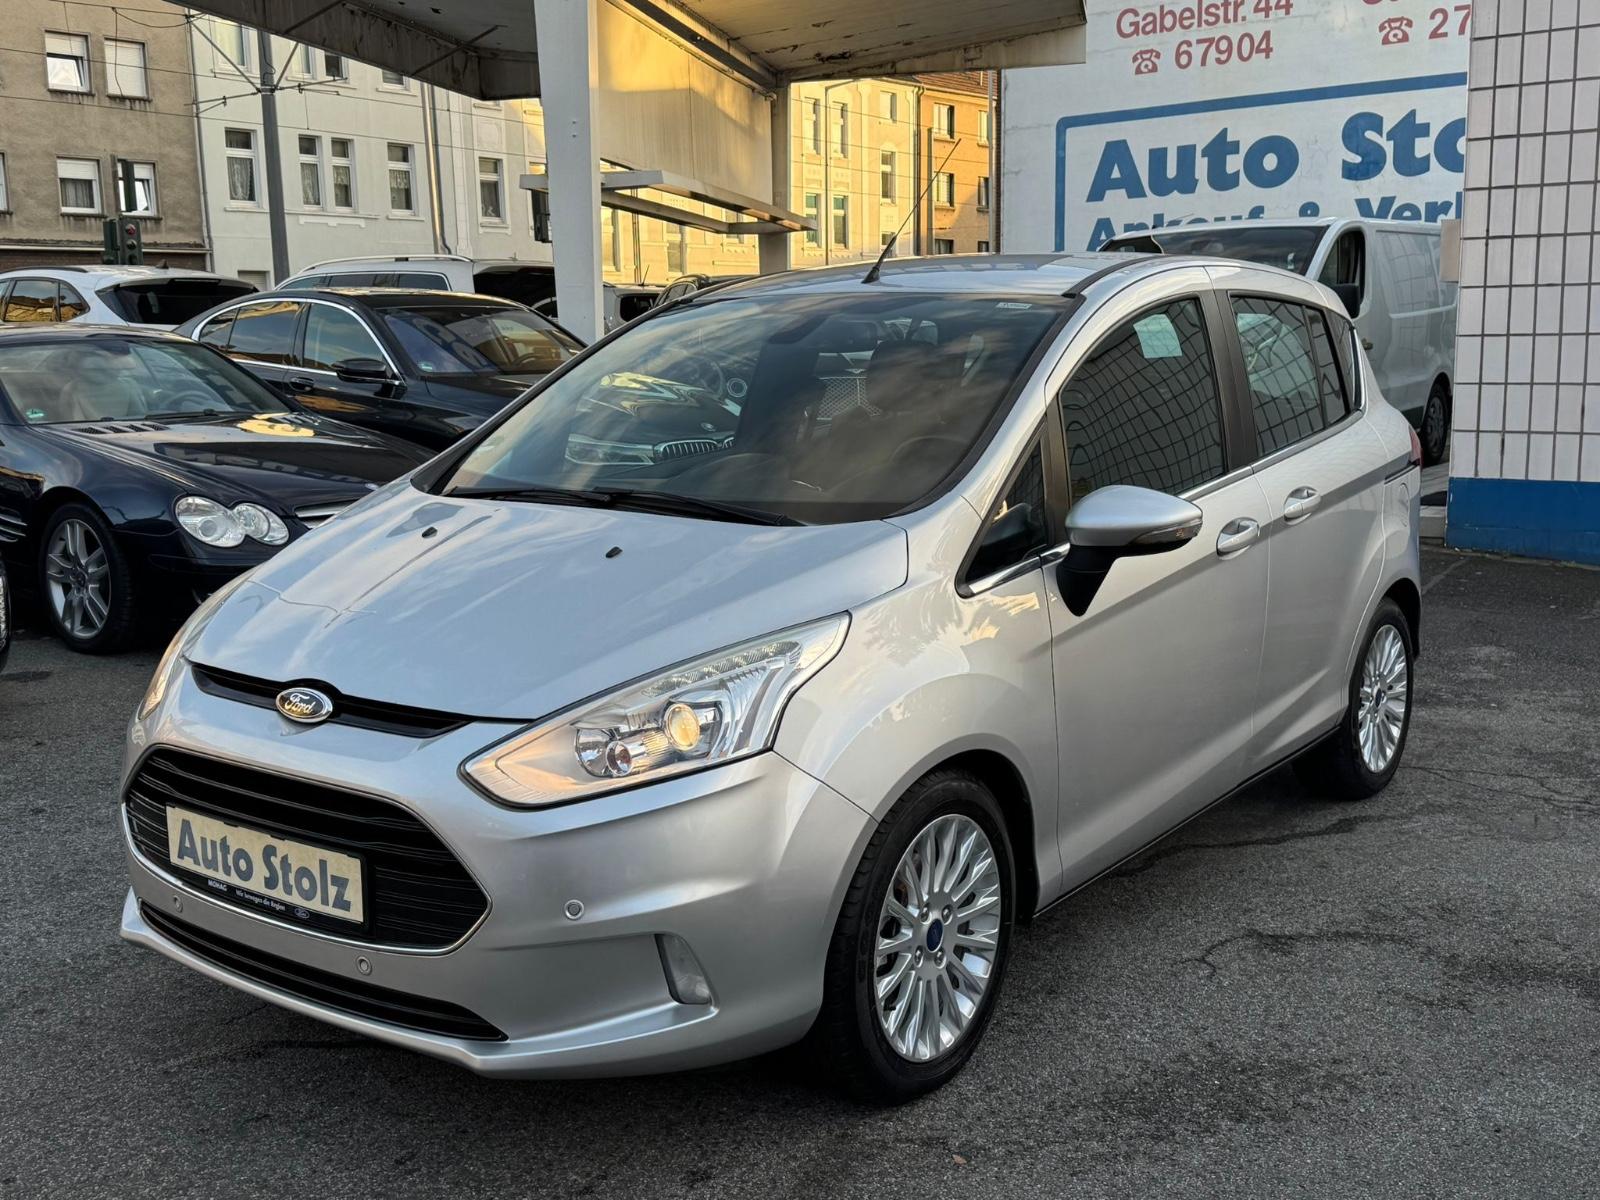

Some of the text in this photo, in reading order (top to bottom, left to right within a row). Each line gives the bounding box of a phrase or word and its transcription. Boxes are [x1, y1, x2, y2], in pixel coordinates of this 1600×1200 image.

[1116, 0, 1294, 39] Gabelstr. 44
[1428, 4, 1472, 40] 27
[1174, 30, 1274, 70] 67904
[1086, 127, 1300, 203] Auto
[284, 692, 316, 714] Ford
[177, 818, 352, 913] Auto Stolz
